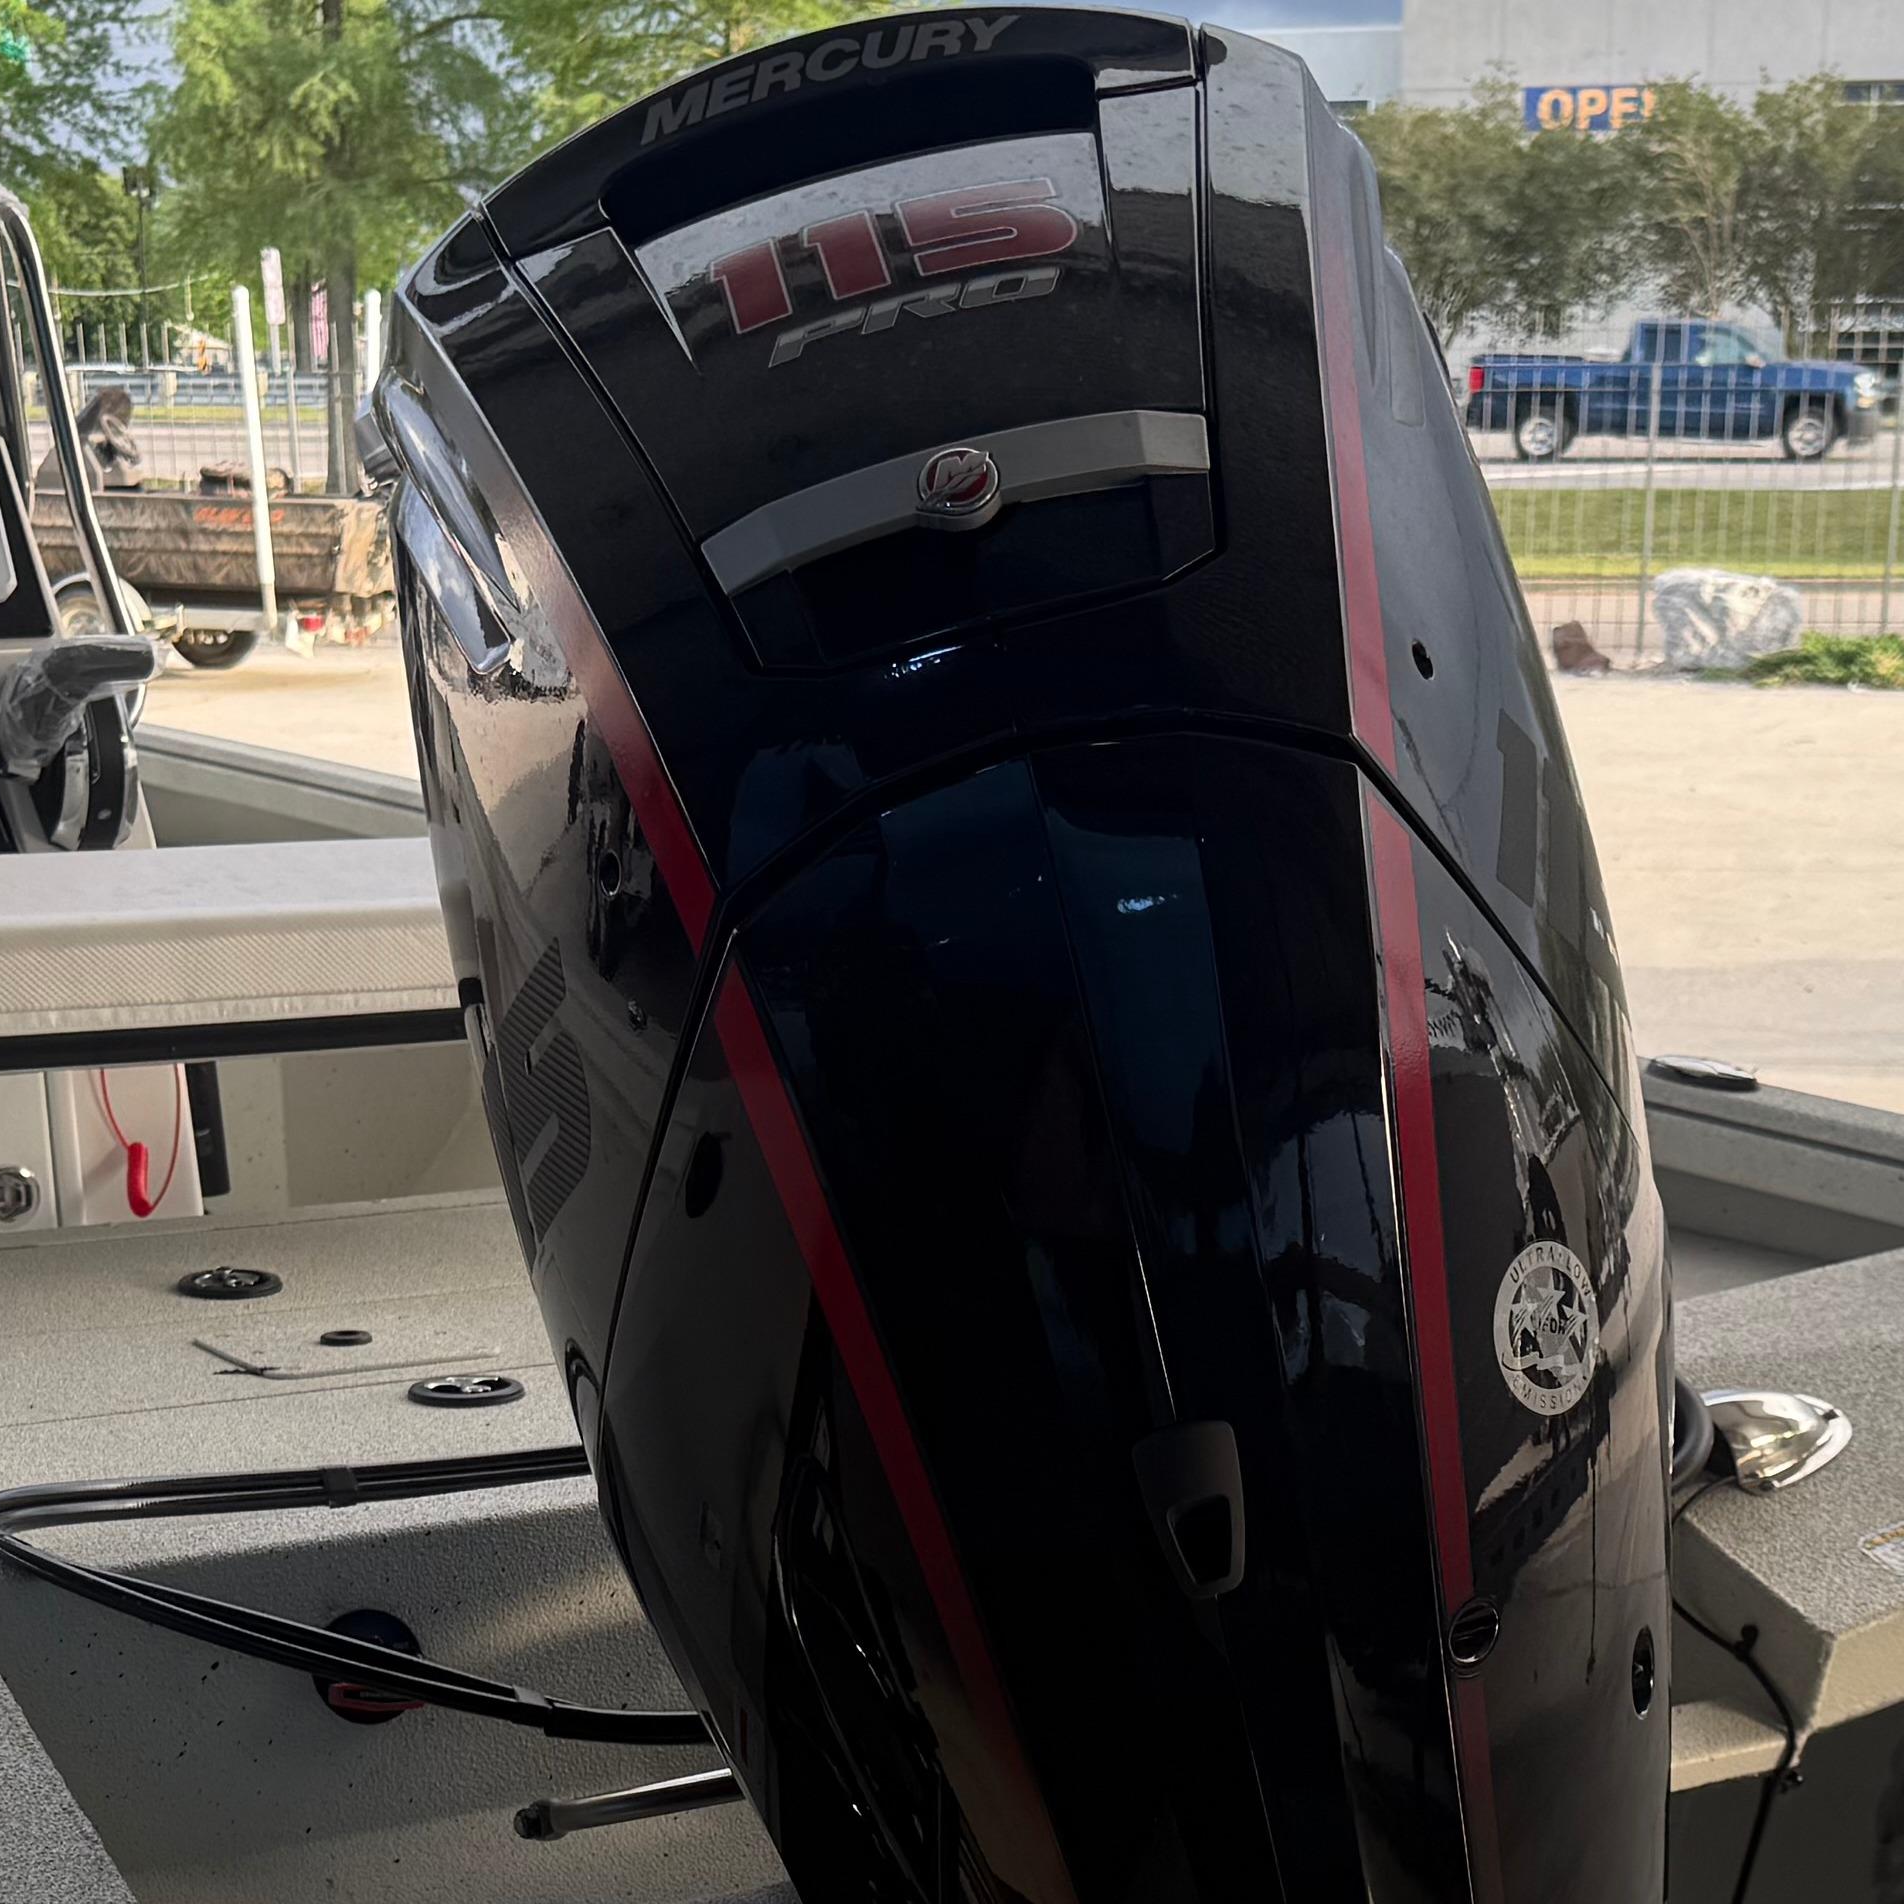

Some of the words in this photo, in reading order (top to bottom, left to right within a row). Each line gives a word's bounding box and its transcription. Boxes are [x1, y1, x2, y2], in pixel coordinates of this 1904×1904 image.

[641, 14, 1020, 147] MERCURY
[709, 177, 1080, 335] 115
[768, 264, 1061, 368] PRO
